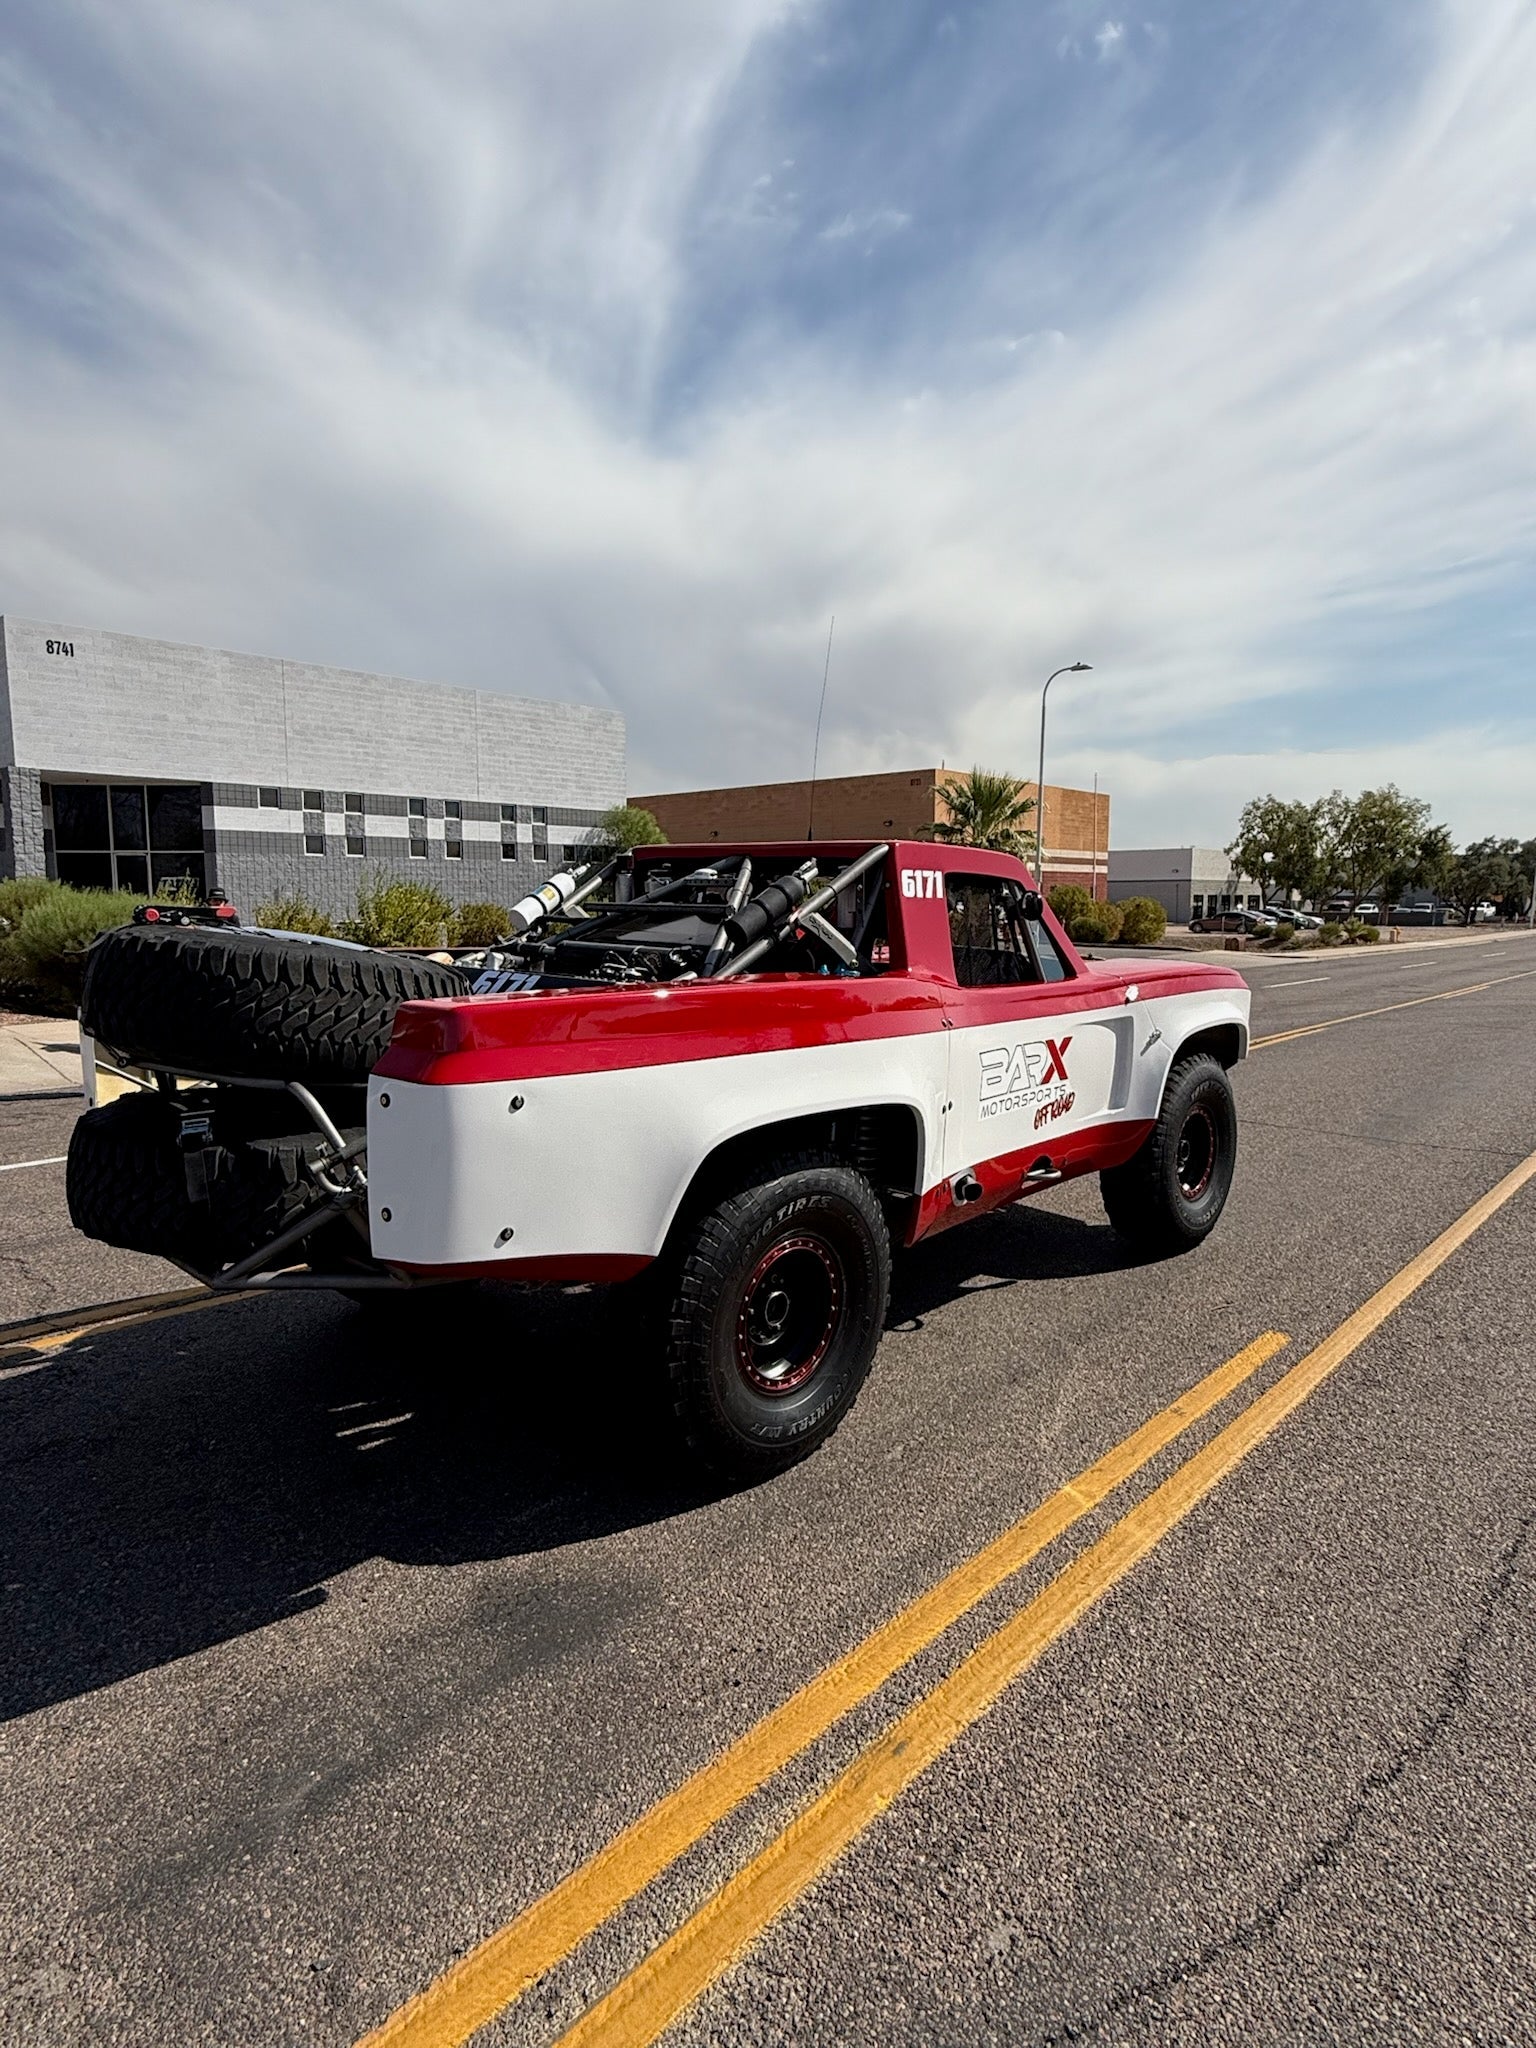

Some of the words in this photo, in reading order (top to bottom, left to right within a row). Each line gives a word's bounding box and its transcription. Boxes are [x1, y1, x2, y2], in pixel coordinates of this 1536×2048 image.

[46, 639, 74, 657] 8741
[901, 869, 944, 899] 6171
[472, 970, 541, 995] 6171
[979, 1036, 1073, 1102] BARX
[981, 1084, 1066, 1119] MOTORSPORTS
[776, 1195, 833, 1222] TIRES
